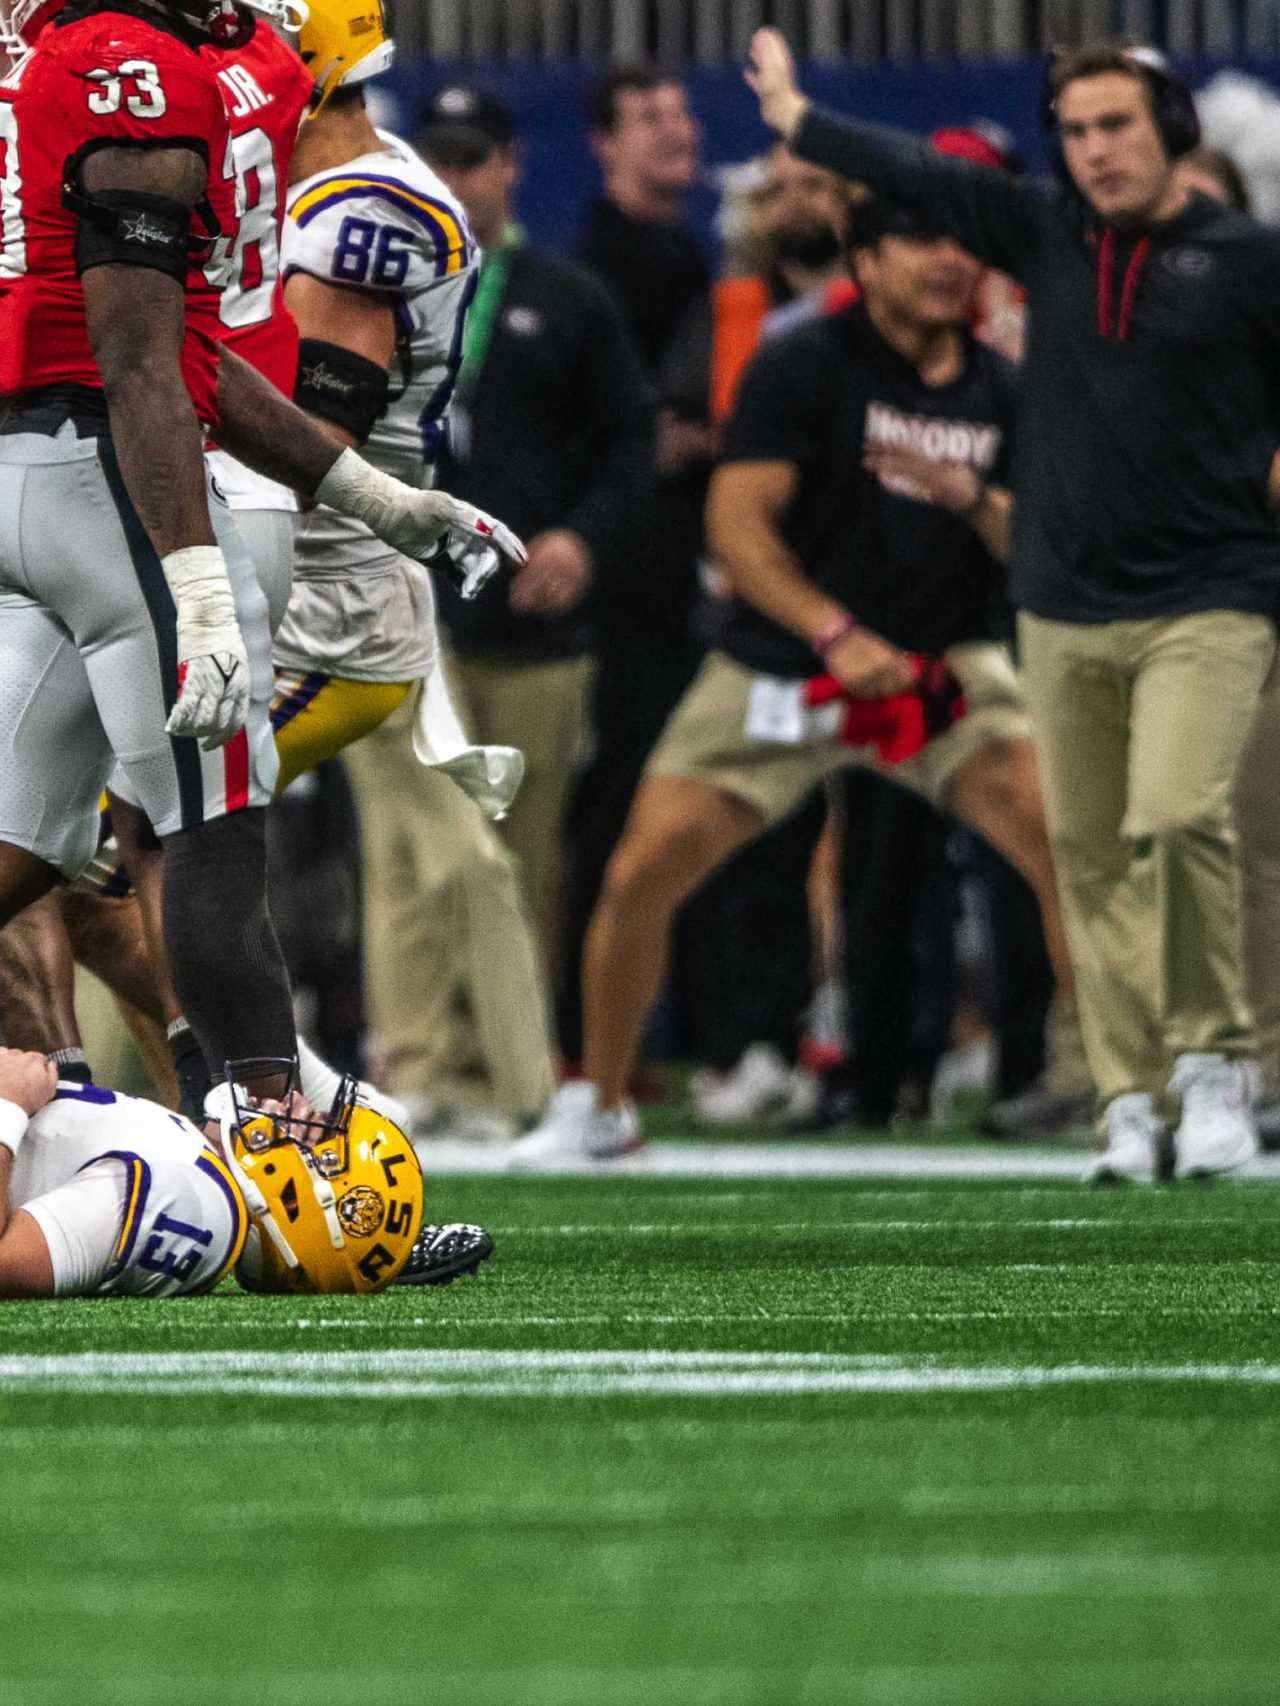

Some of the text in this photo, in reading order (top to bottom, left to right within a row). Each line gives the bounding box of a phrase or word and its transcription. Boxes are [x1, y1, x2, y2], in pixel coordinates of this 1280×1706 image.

[84, 60, 167, 118] 33
[217, 63, 274, 118] JR.
[330, 215, 410, 286] 86
[138, 1211, 213, 1282] 13
